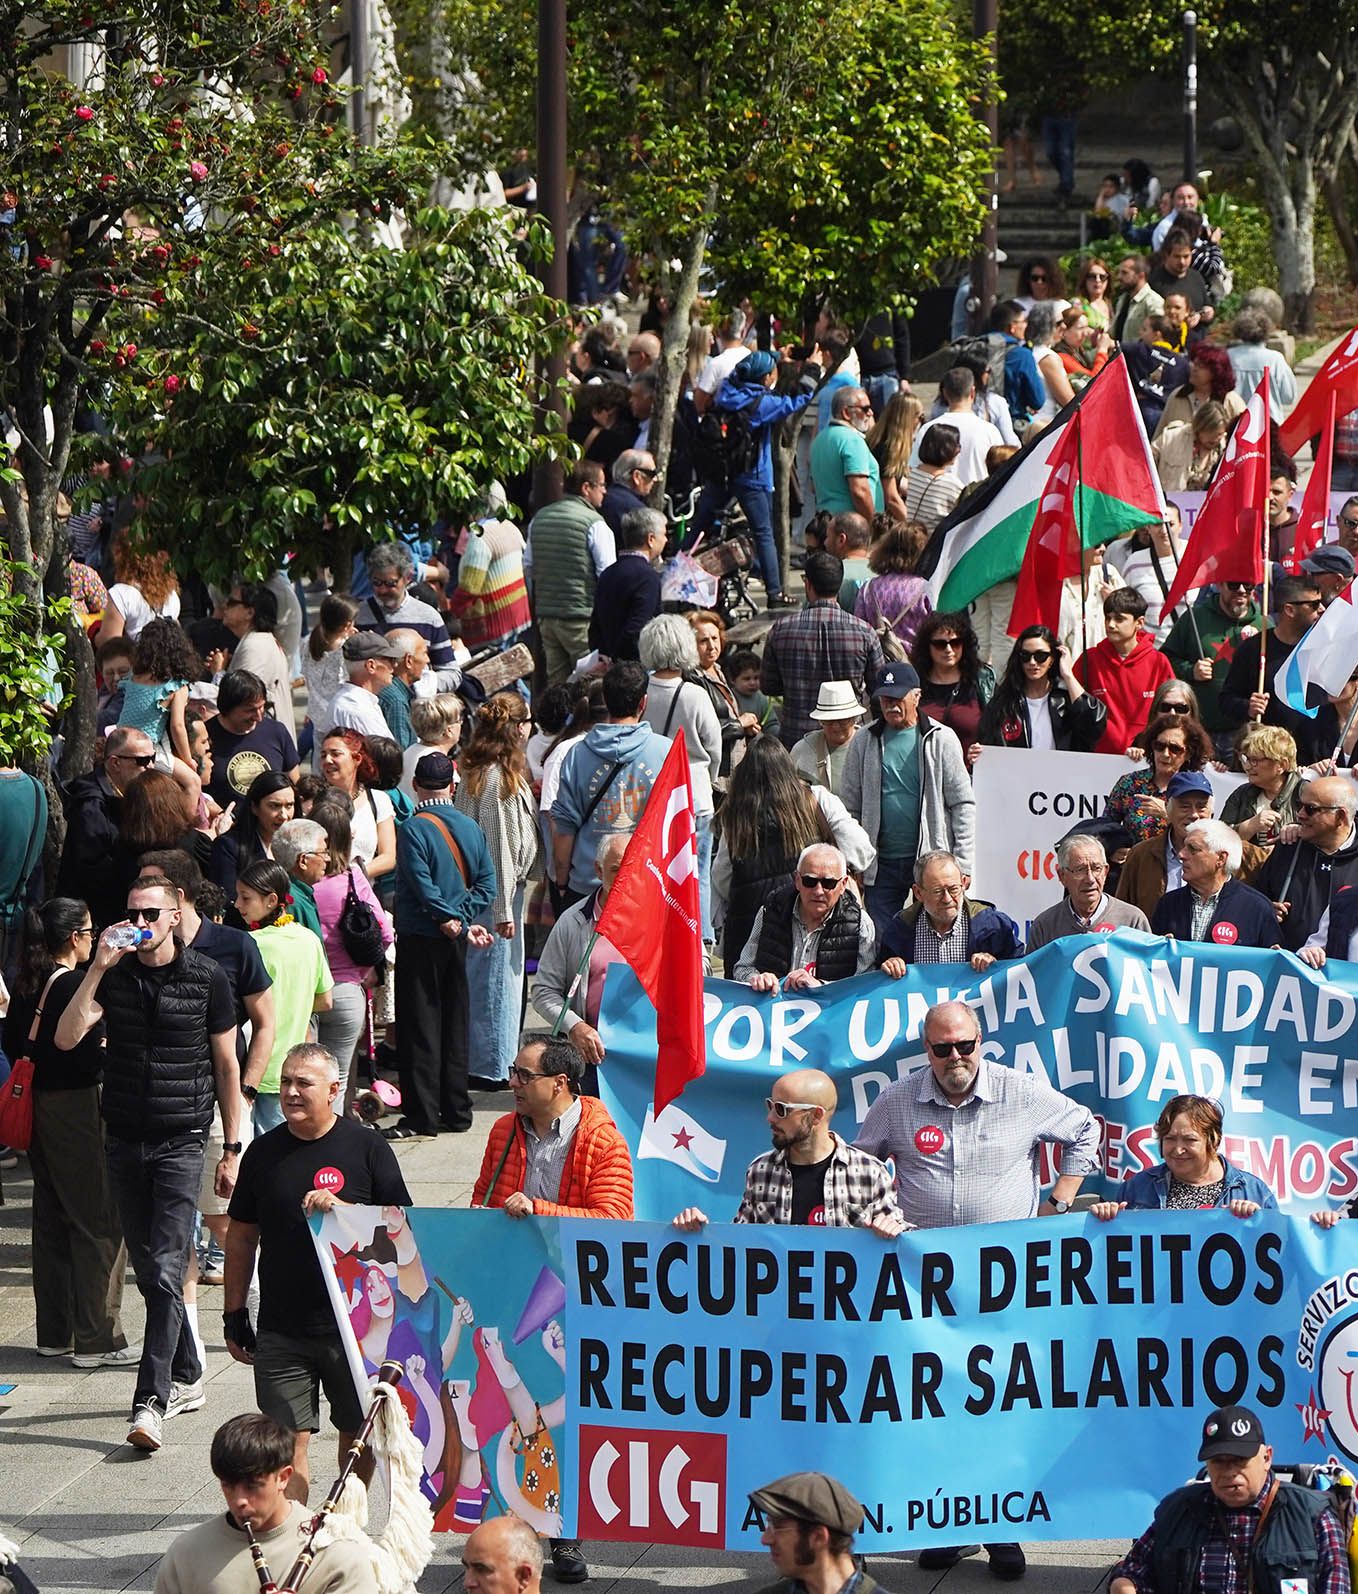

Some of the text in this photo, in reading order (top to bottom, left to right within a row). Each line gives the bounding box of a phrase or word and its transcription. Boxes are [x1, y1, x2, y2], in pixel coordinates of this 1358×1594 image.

[1222, 1137, 1358, 1197] EMOS
[576, 1232, 1284, 1321] RECUPERAR DEREITOS
[579, 1335, 1285, 1424] RECUPERAR SALARIOS
[588, 1440, 719, 1533] CIG
[908, 1487, 1050, 1530] PÚBLICA
